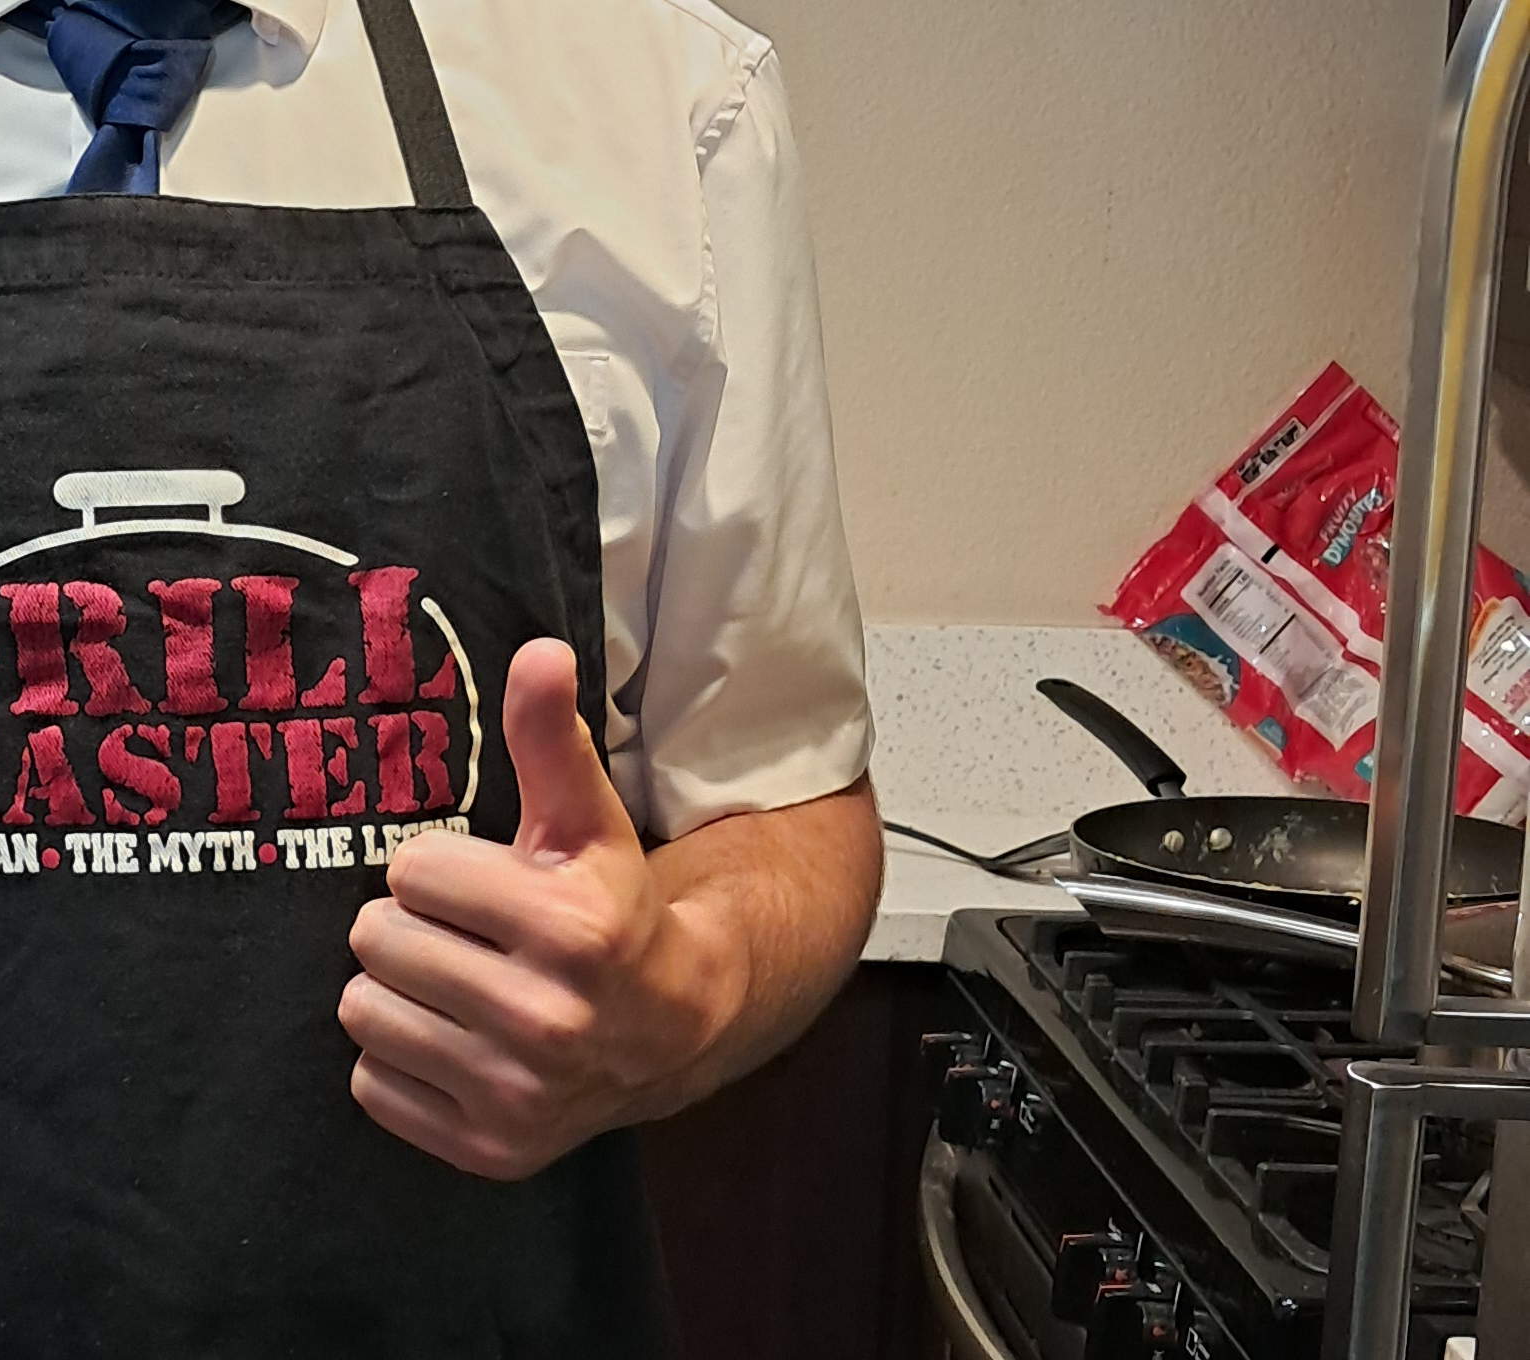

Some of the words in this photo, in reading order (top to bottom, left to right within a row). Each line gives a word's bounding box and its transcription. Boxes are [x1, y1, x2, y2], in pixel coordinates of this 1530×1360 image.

[64, 832, 140, 874] THE
[147, 830, 257, 873] MYTH
[276, 826, 355, 870] THE
